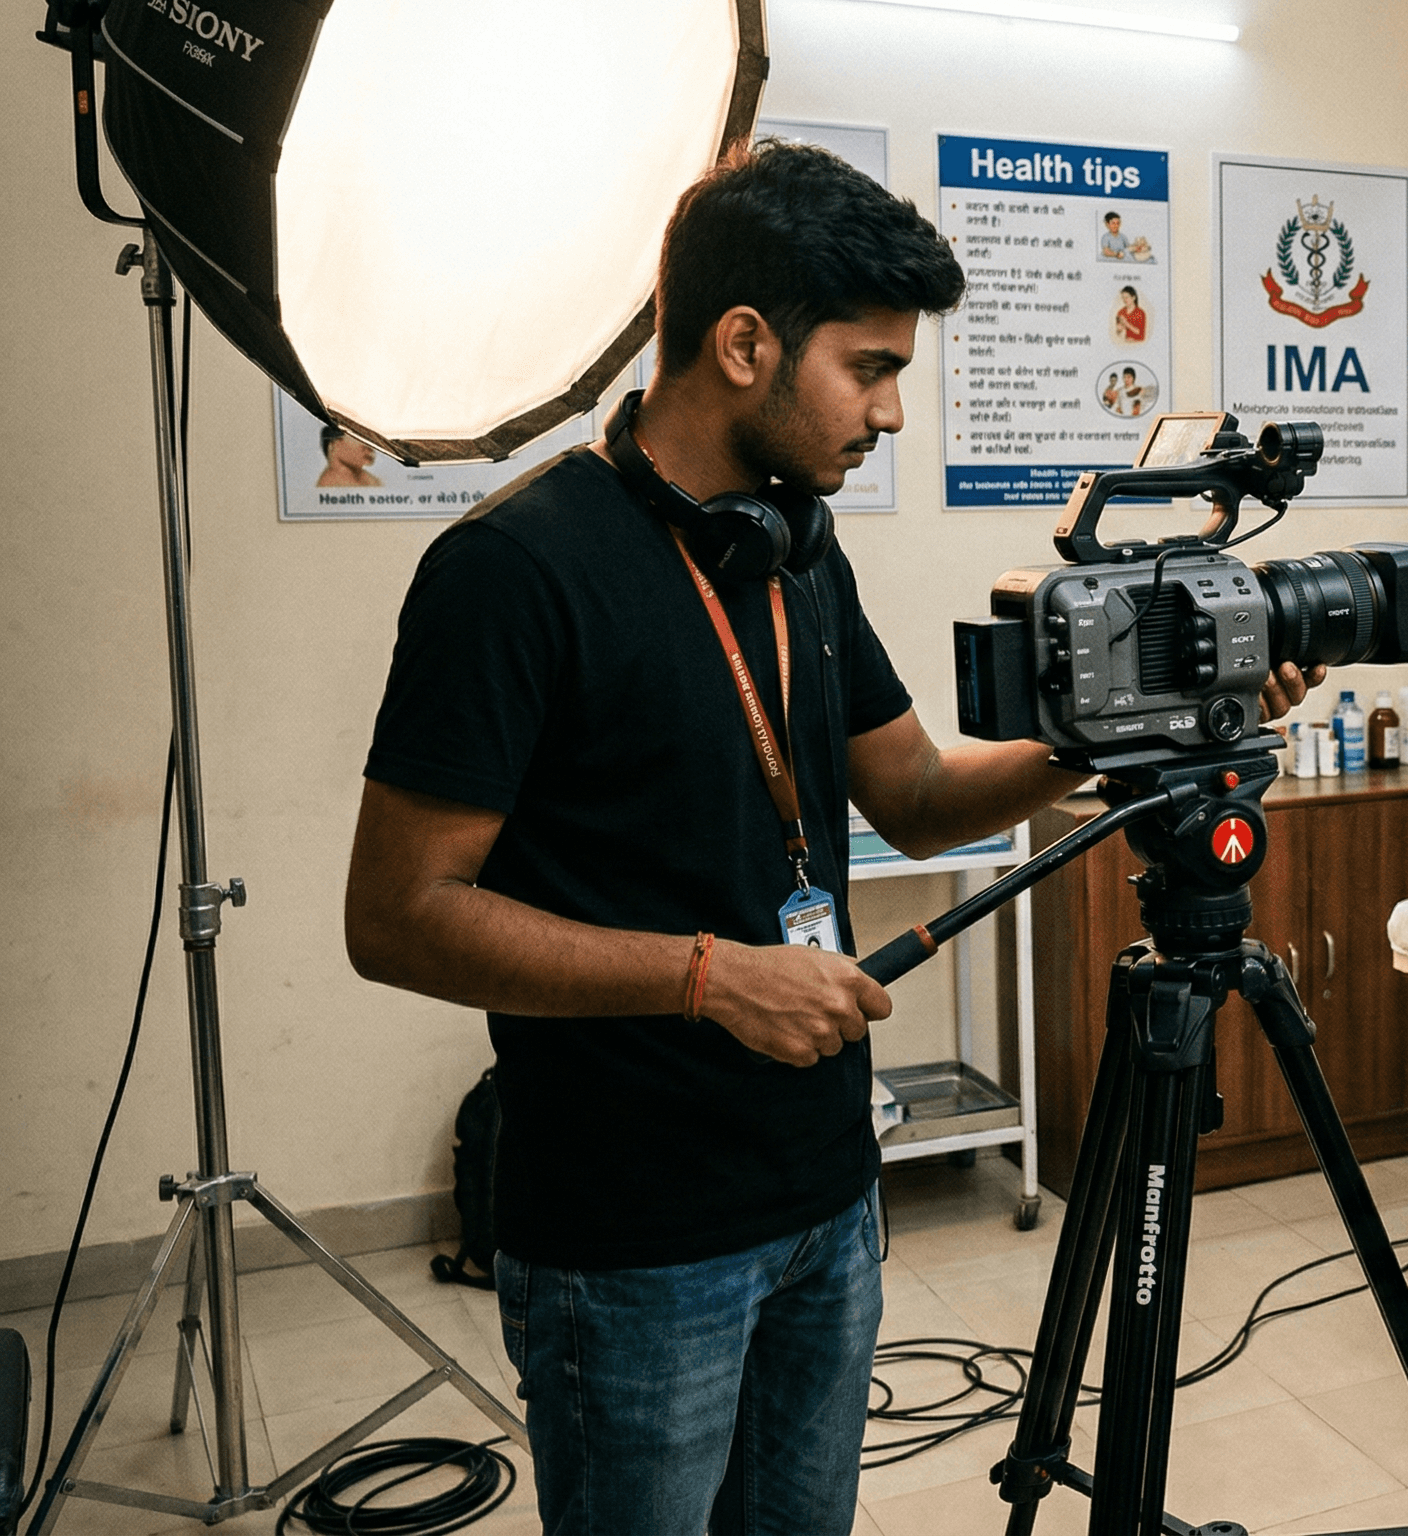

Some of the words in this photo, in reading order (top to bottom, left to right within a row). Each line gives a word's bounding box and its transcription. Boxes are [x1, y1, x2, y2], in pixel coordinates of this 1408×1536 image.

[970, 148, 1074, 185] Health
[1082, 157, 1141, 194] tips
[1266, 344, 1371, 394] IMA
[319, 493, 365, 505] Health
[1134, 1163, 1167, 1307] Manfrotto
